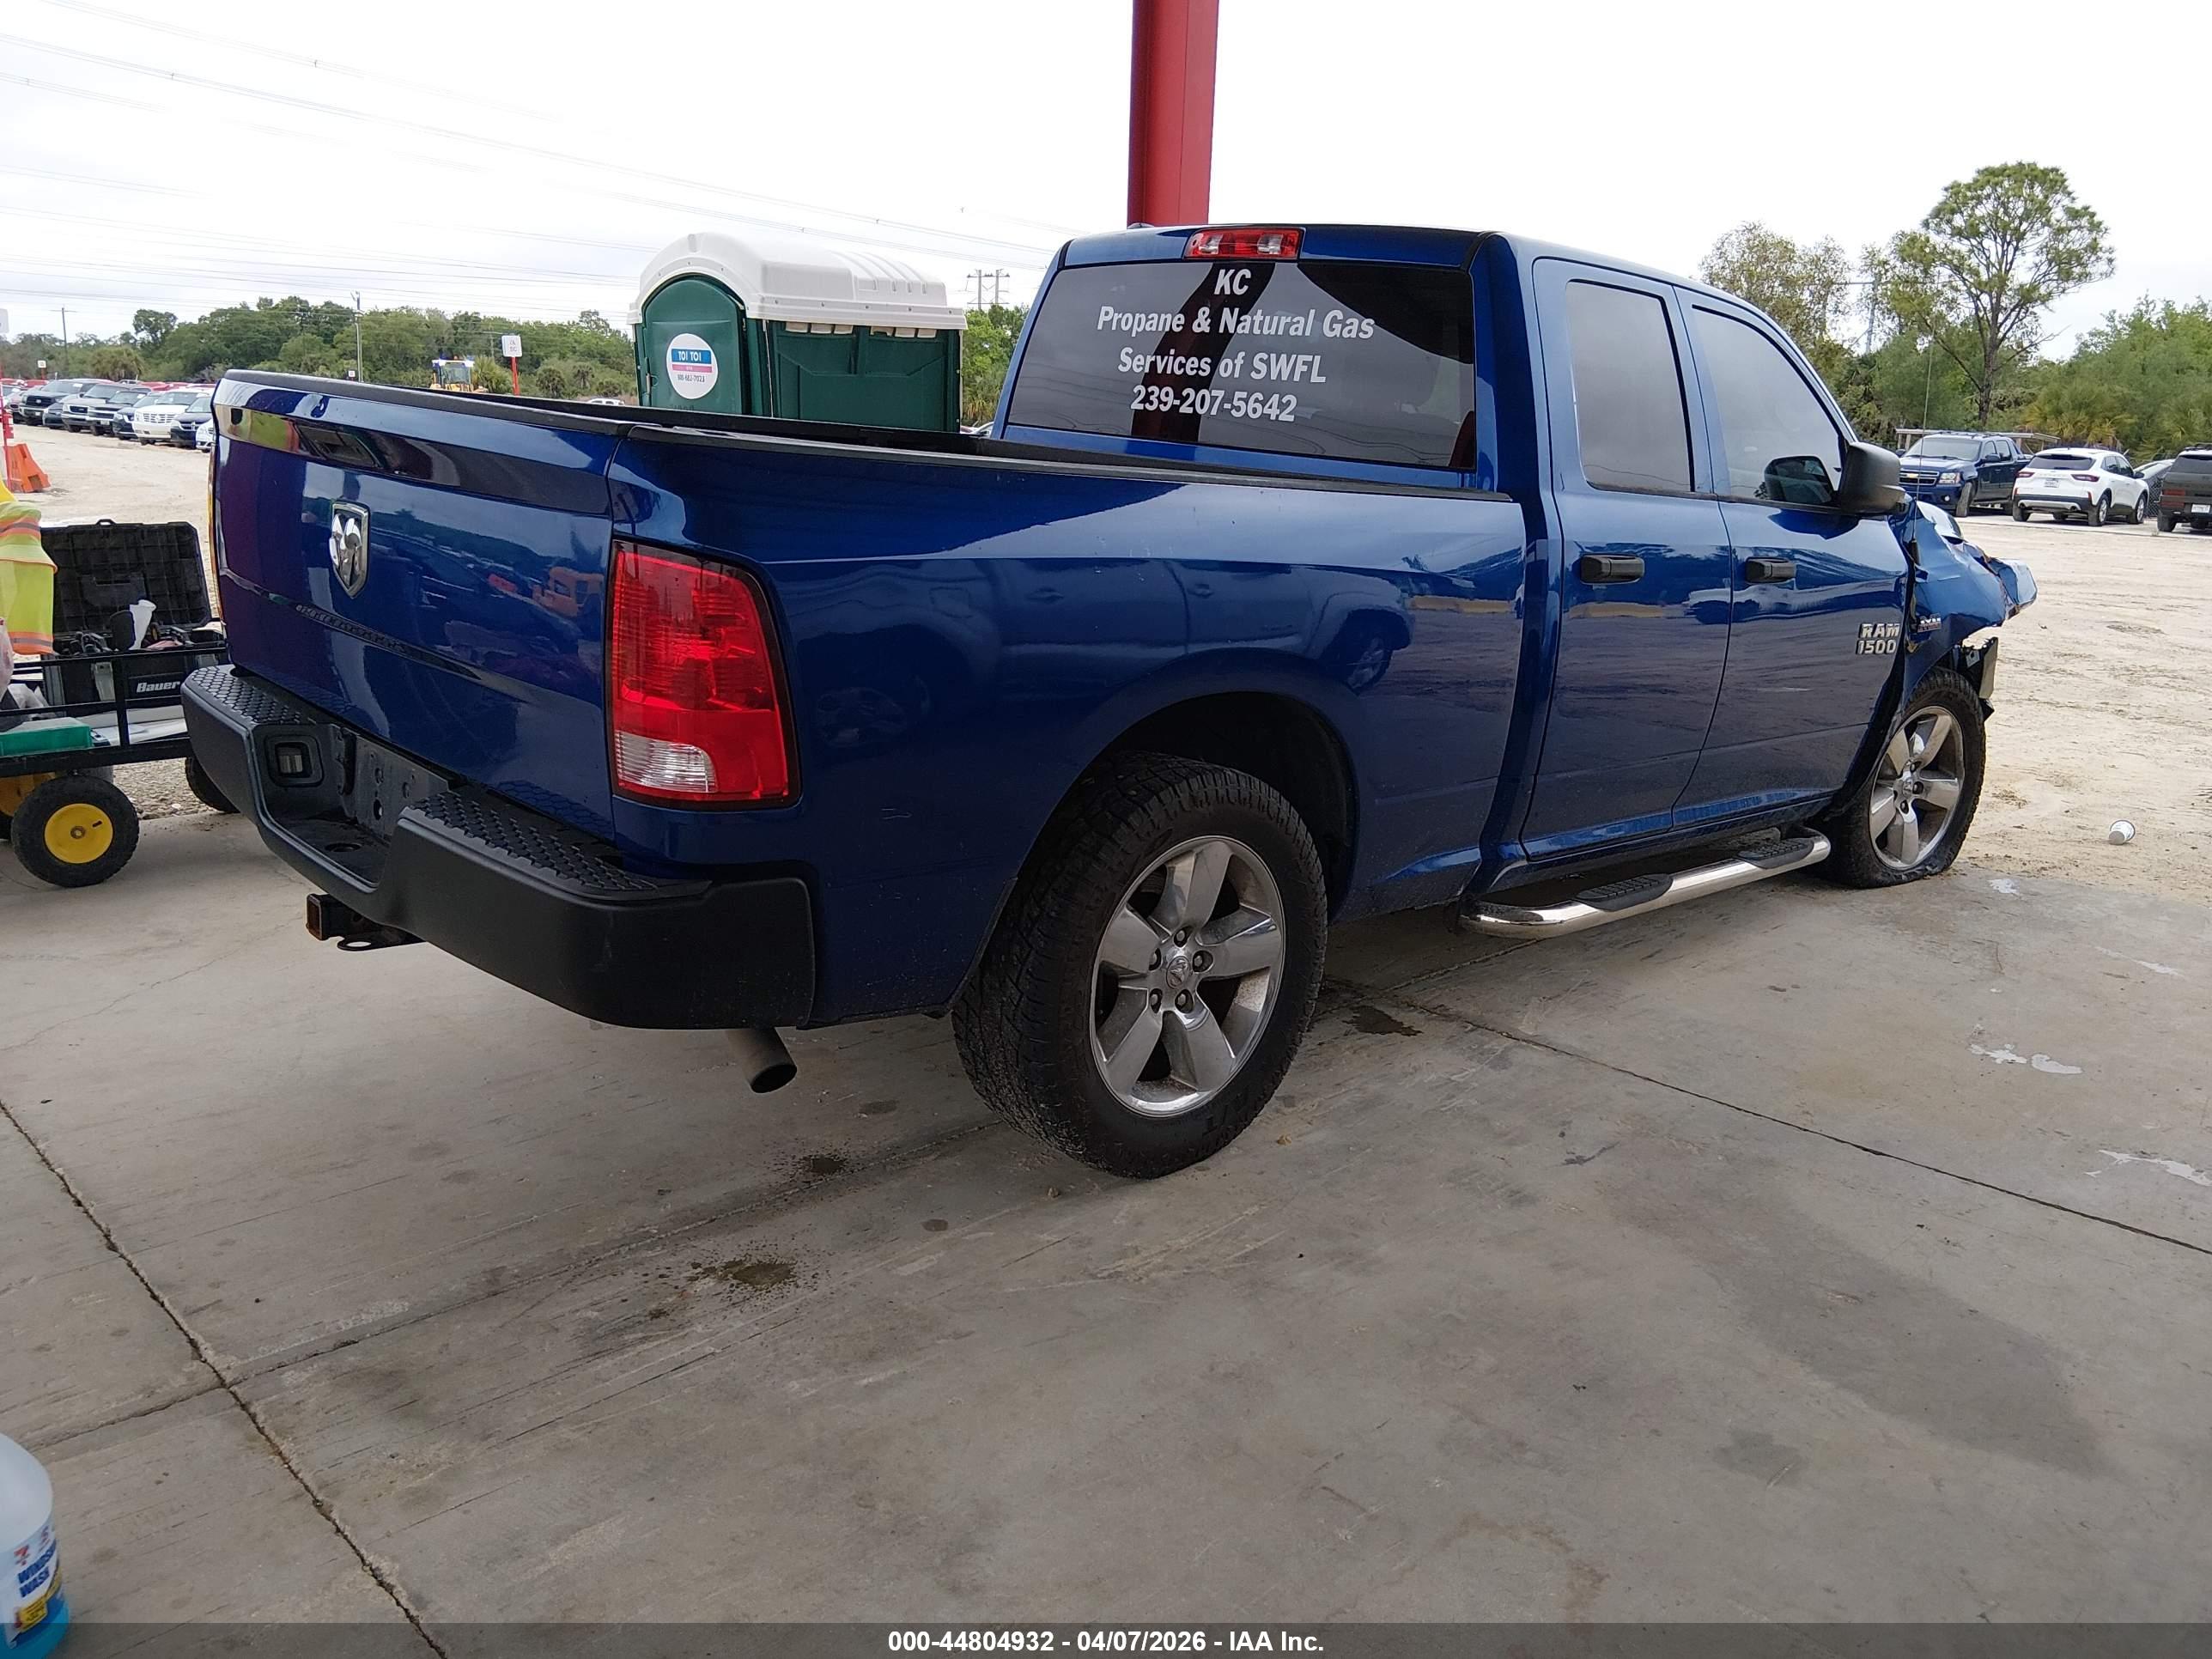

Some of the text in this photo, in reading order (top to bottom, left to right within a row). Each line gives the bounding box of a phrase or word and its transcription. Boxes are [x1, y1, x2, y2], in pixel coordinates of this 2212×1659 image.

[1213, 269, 1251, 295] KC
[1097, 306, 1376, 339] Propane & Natural Gas
[1118, 347, 1327, 383] Services of SWFL
[1130, 385, 1298, 422] 239-207-5642
[1858, 623, 1901, 639] RAM
[1856, 639, 1898, 655] 1500
[136, 681, 181, 693] Bauer
